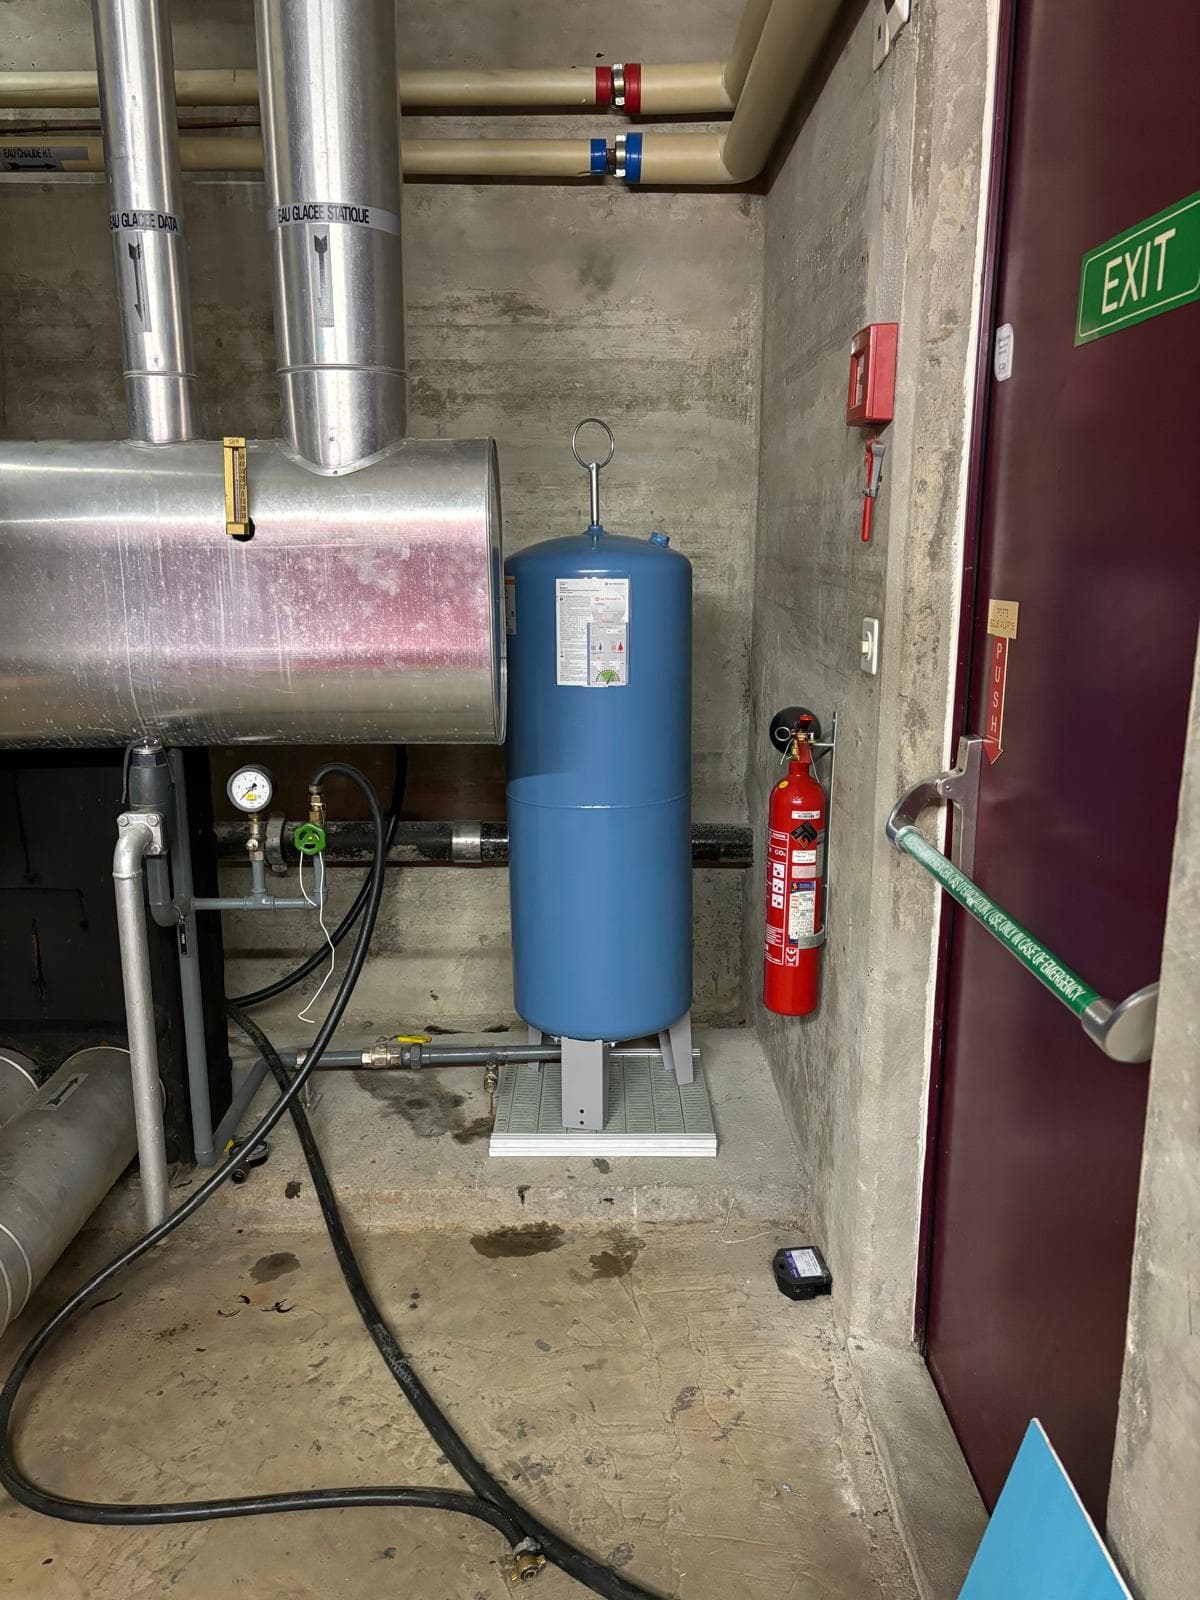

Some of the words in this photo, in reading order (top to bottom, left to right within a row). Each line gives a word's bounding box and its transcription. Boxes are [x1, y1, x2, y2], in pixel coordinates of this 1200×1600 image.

[157, 214, 178, 232] DATA
[278, 207, 291, 223] EAU
[327, 204, 370, 224] STATIQUE
[1101, 227, 1176, 315] EXIT
[990, 643, 1003, 733] PUSH
[1040, 959, 1086, 1002] EMERGENCY
